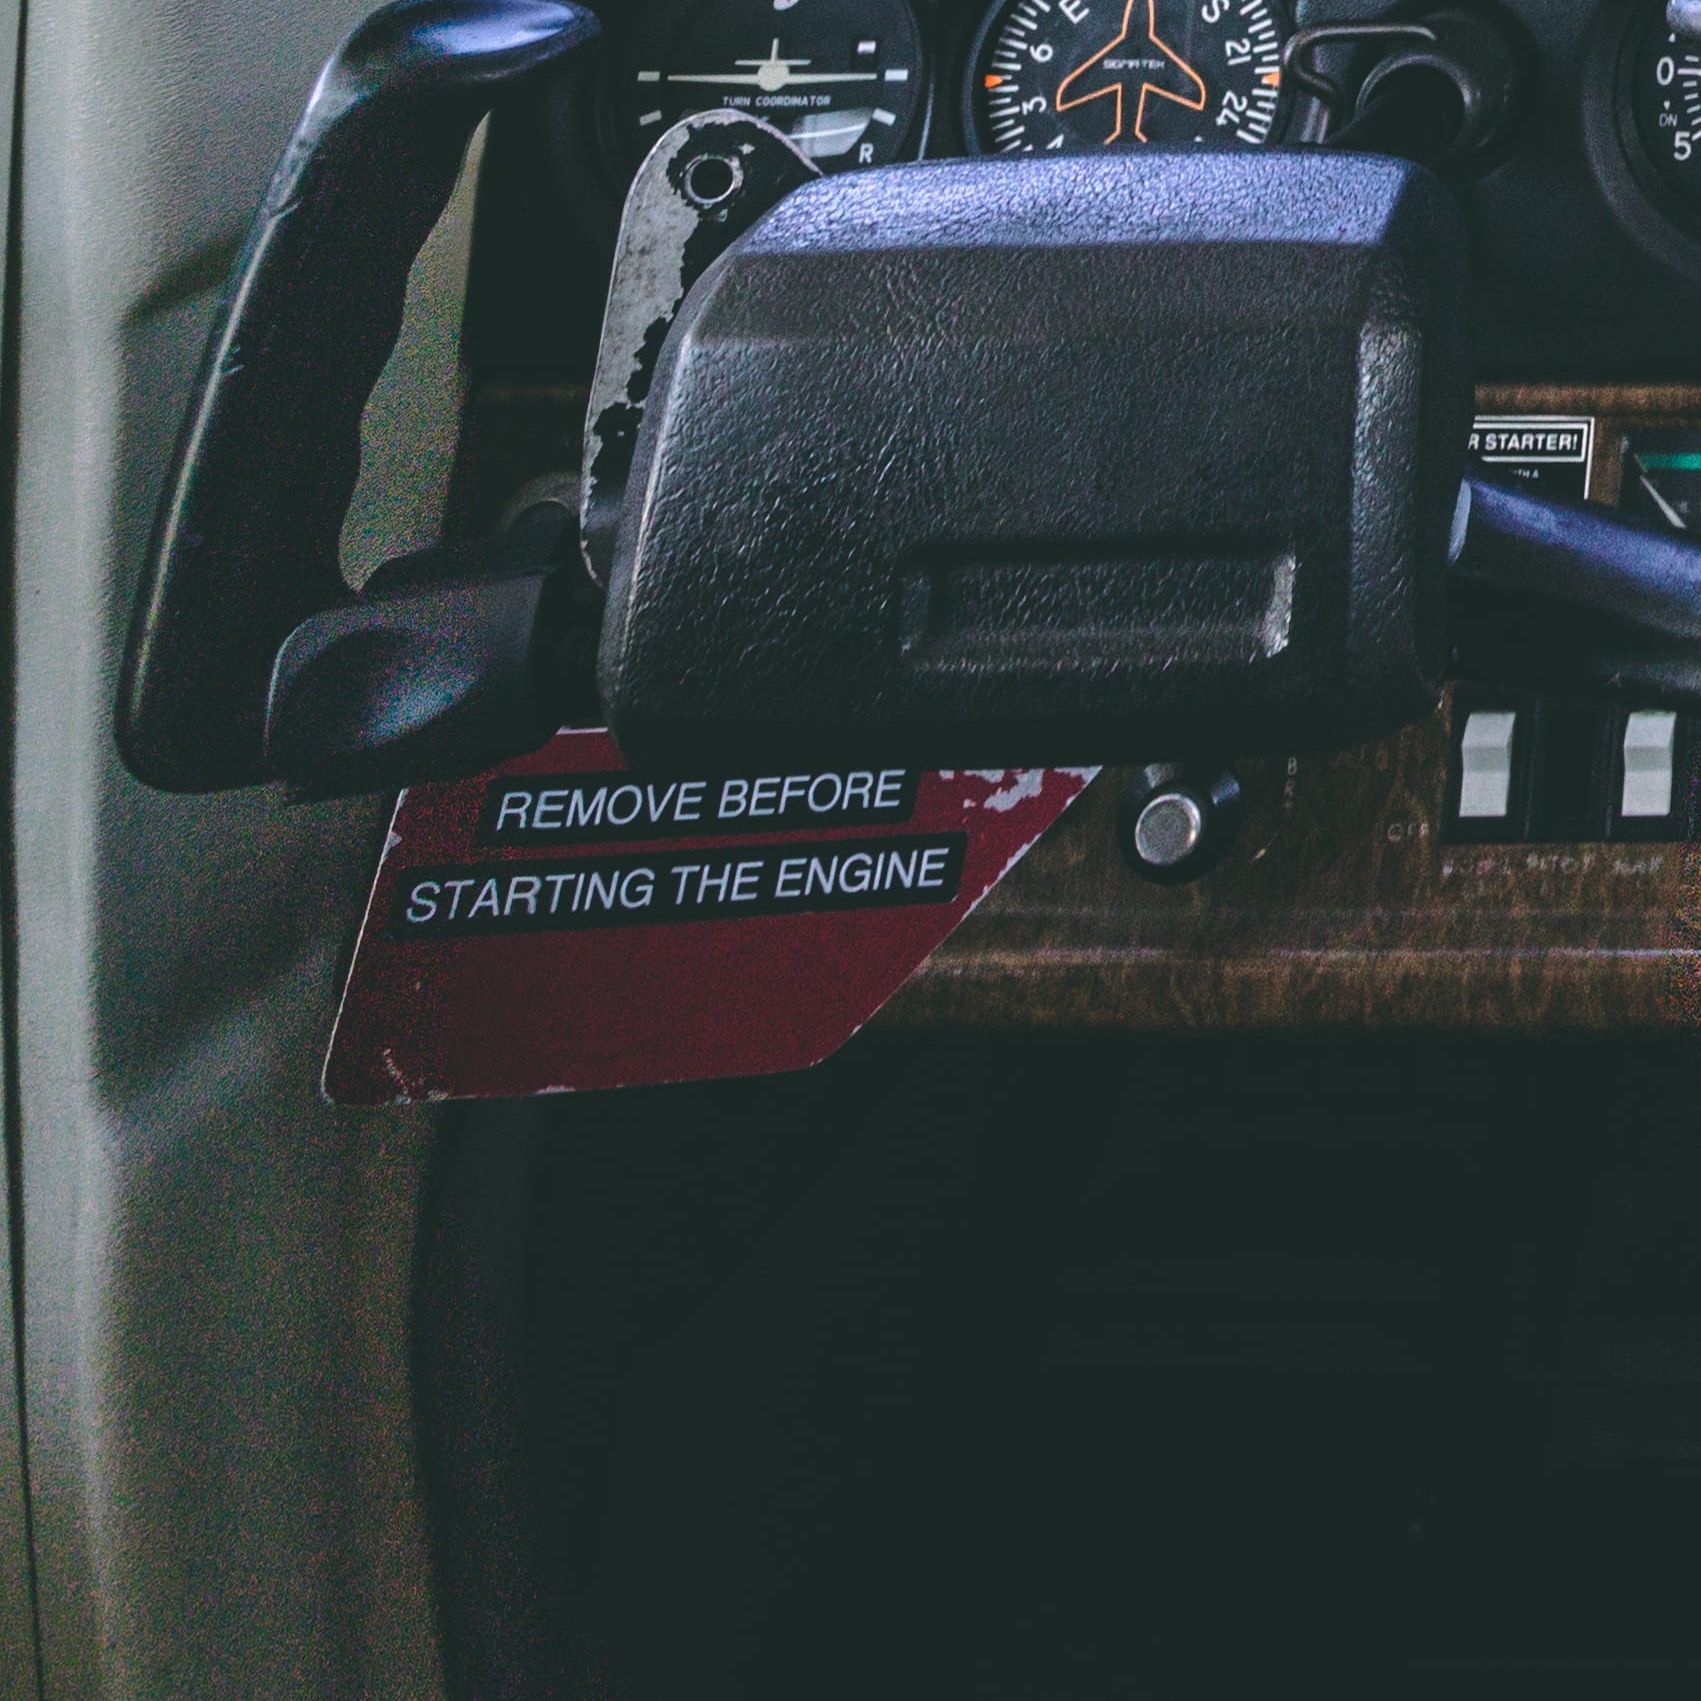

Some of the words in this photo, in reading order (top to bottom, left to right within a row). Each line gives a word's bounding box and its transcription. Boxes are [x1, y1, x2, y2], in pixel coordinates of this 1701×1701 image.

[1029, 43, 1053, 63] 6
[1226, 40, 1251, 66] 21
[1656, 57, 1674, 86] 0
[723, 96, 751, 107] TURN
[755, 95, 831, 107] COORDINATOR
[1022, 96, 1047, 115] 3
[1216, 90, 1248, 126] 24
[1659, 113, 1678, 127] DN
[858, 143, 874, 164] R
[1674, 132, 1692, 161] 5
[1485, 433, 1579, 451] STARTER!
[496, 782, 702, 832] REMOVE
[717, 769, 906, 820] BEFORE
[405, 868, 655, 924] STARTING
[670, 860, 765, 906] THE
[774, 847, 949, 898] ENGINE
